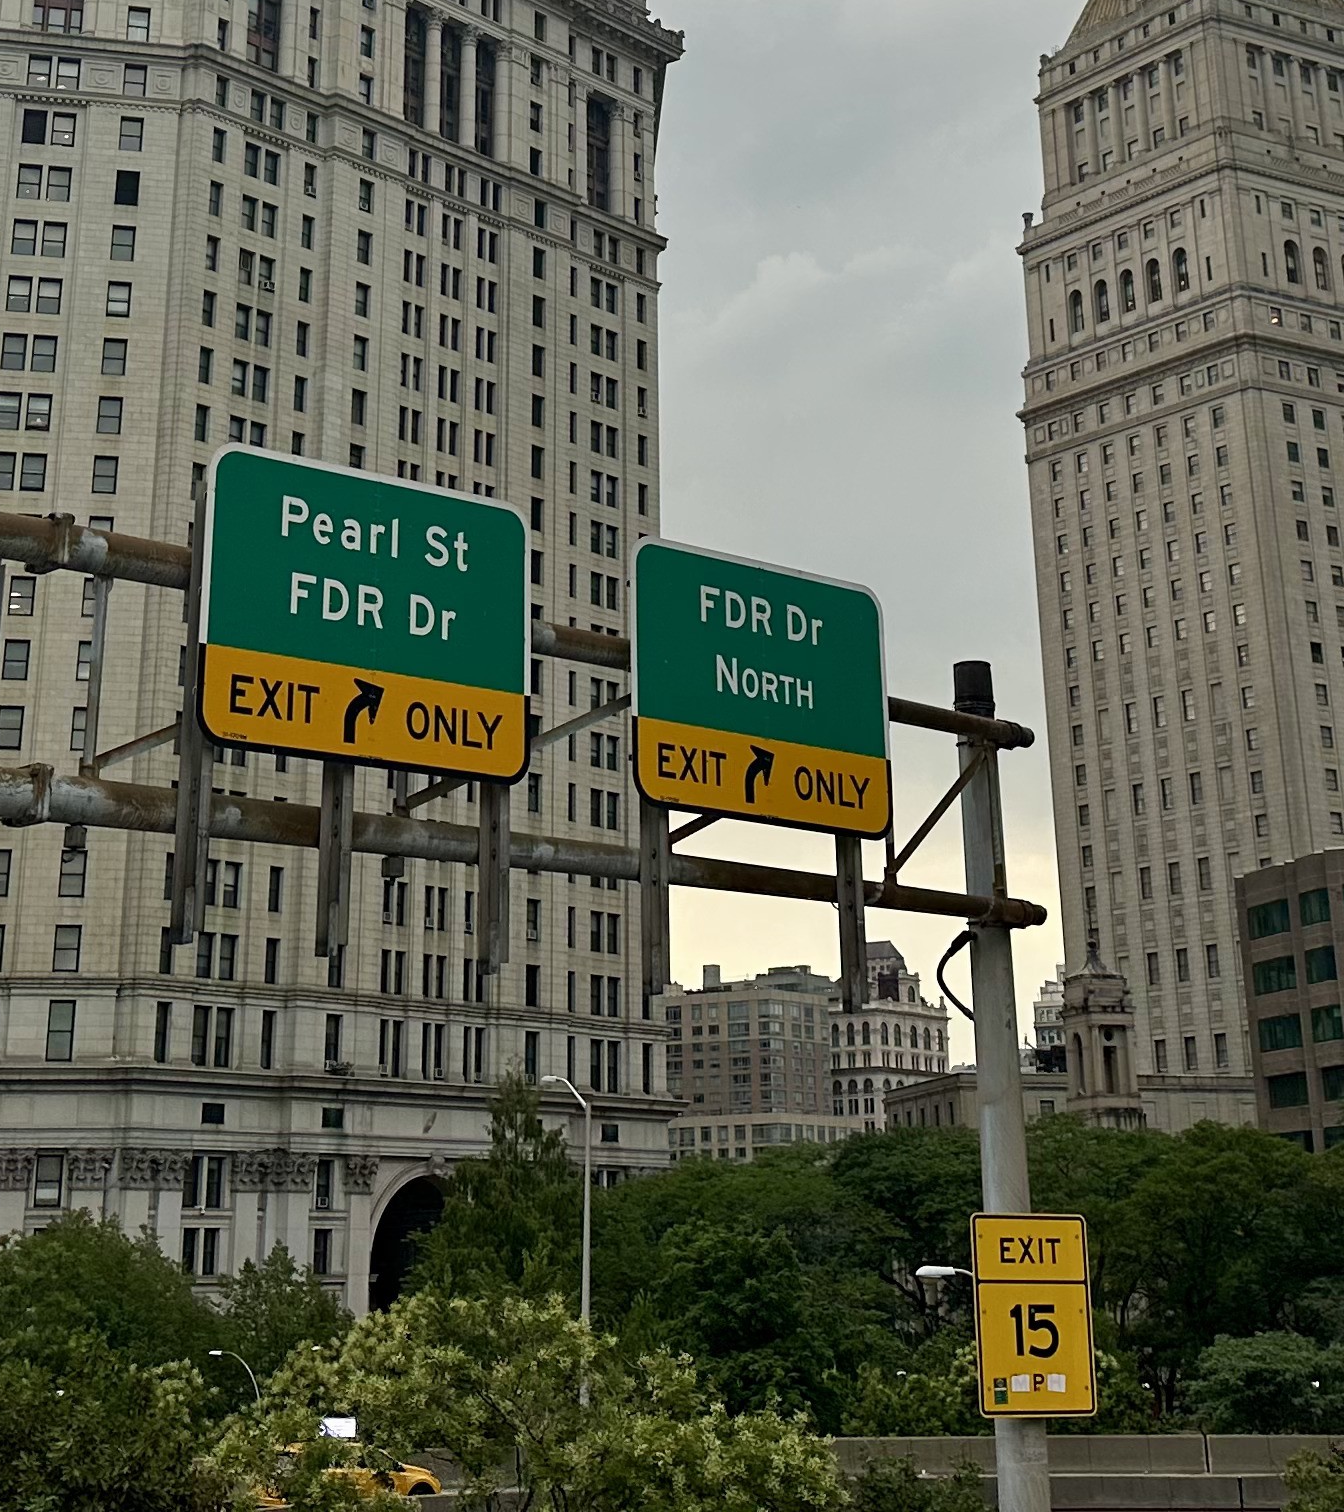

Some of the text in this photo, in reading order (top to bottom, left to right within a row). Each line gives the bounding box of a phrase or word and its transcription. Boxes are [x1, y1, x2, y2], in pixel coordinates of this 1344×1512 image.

[282, 495, 468, 571] Pearl St
[291, 572, 456, 640] FDR Dr
[701, 586, 822, 645] FDR Dr
[230, 674, 502, 749] EXIT ONLY
[717, 655, 812, 709] NORTH
[658, 743, 870, 809] EXIT ONLY
[999, 1237, 1061, 1264] EXIT
[1009, 1304, 1059, 1358] 15
